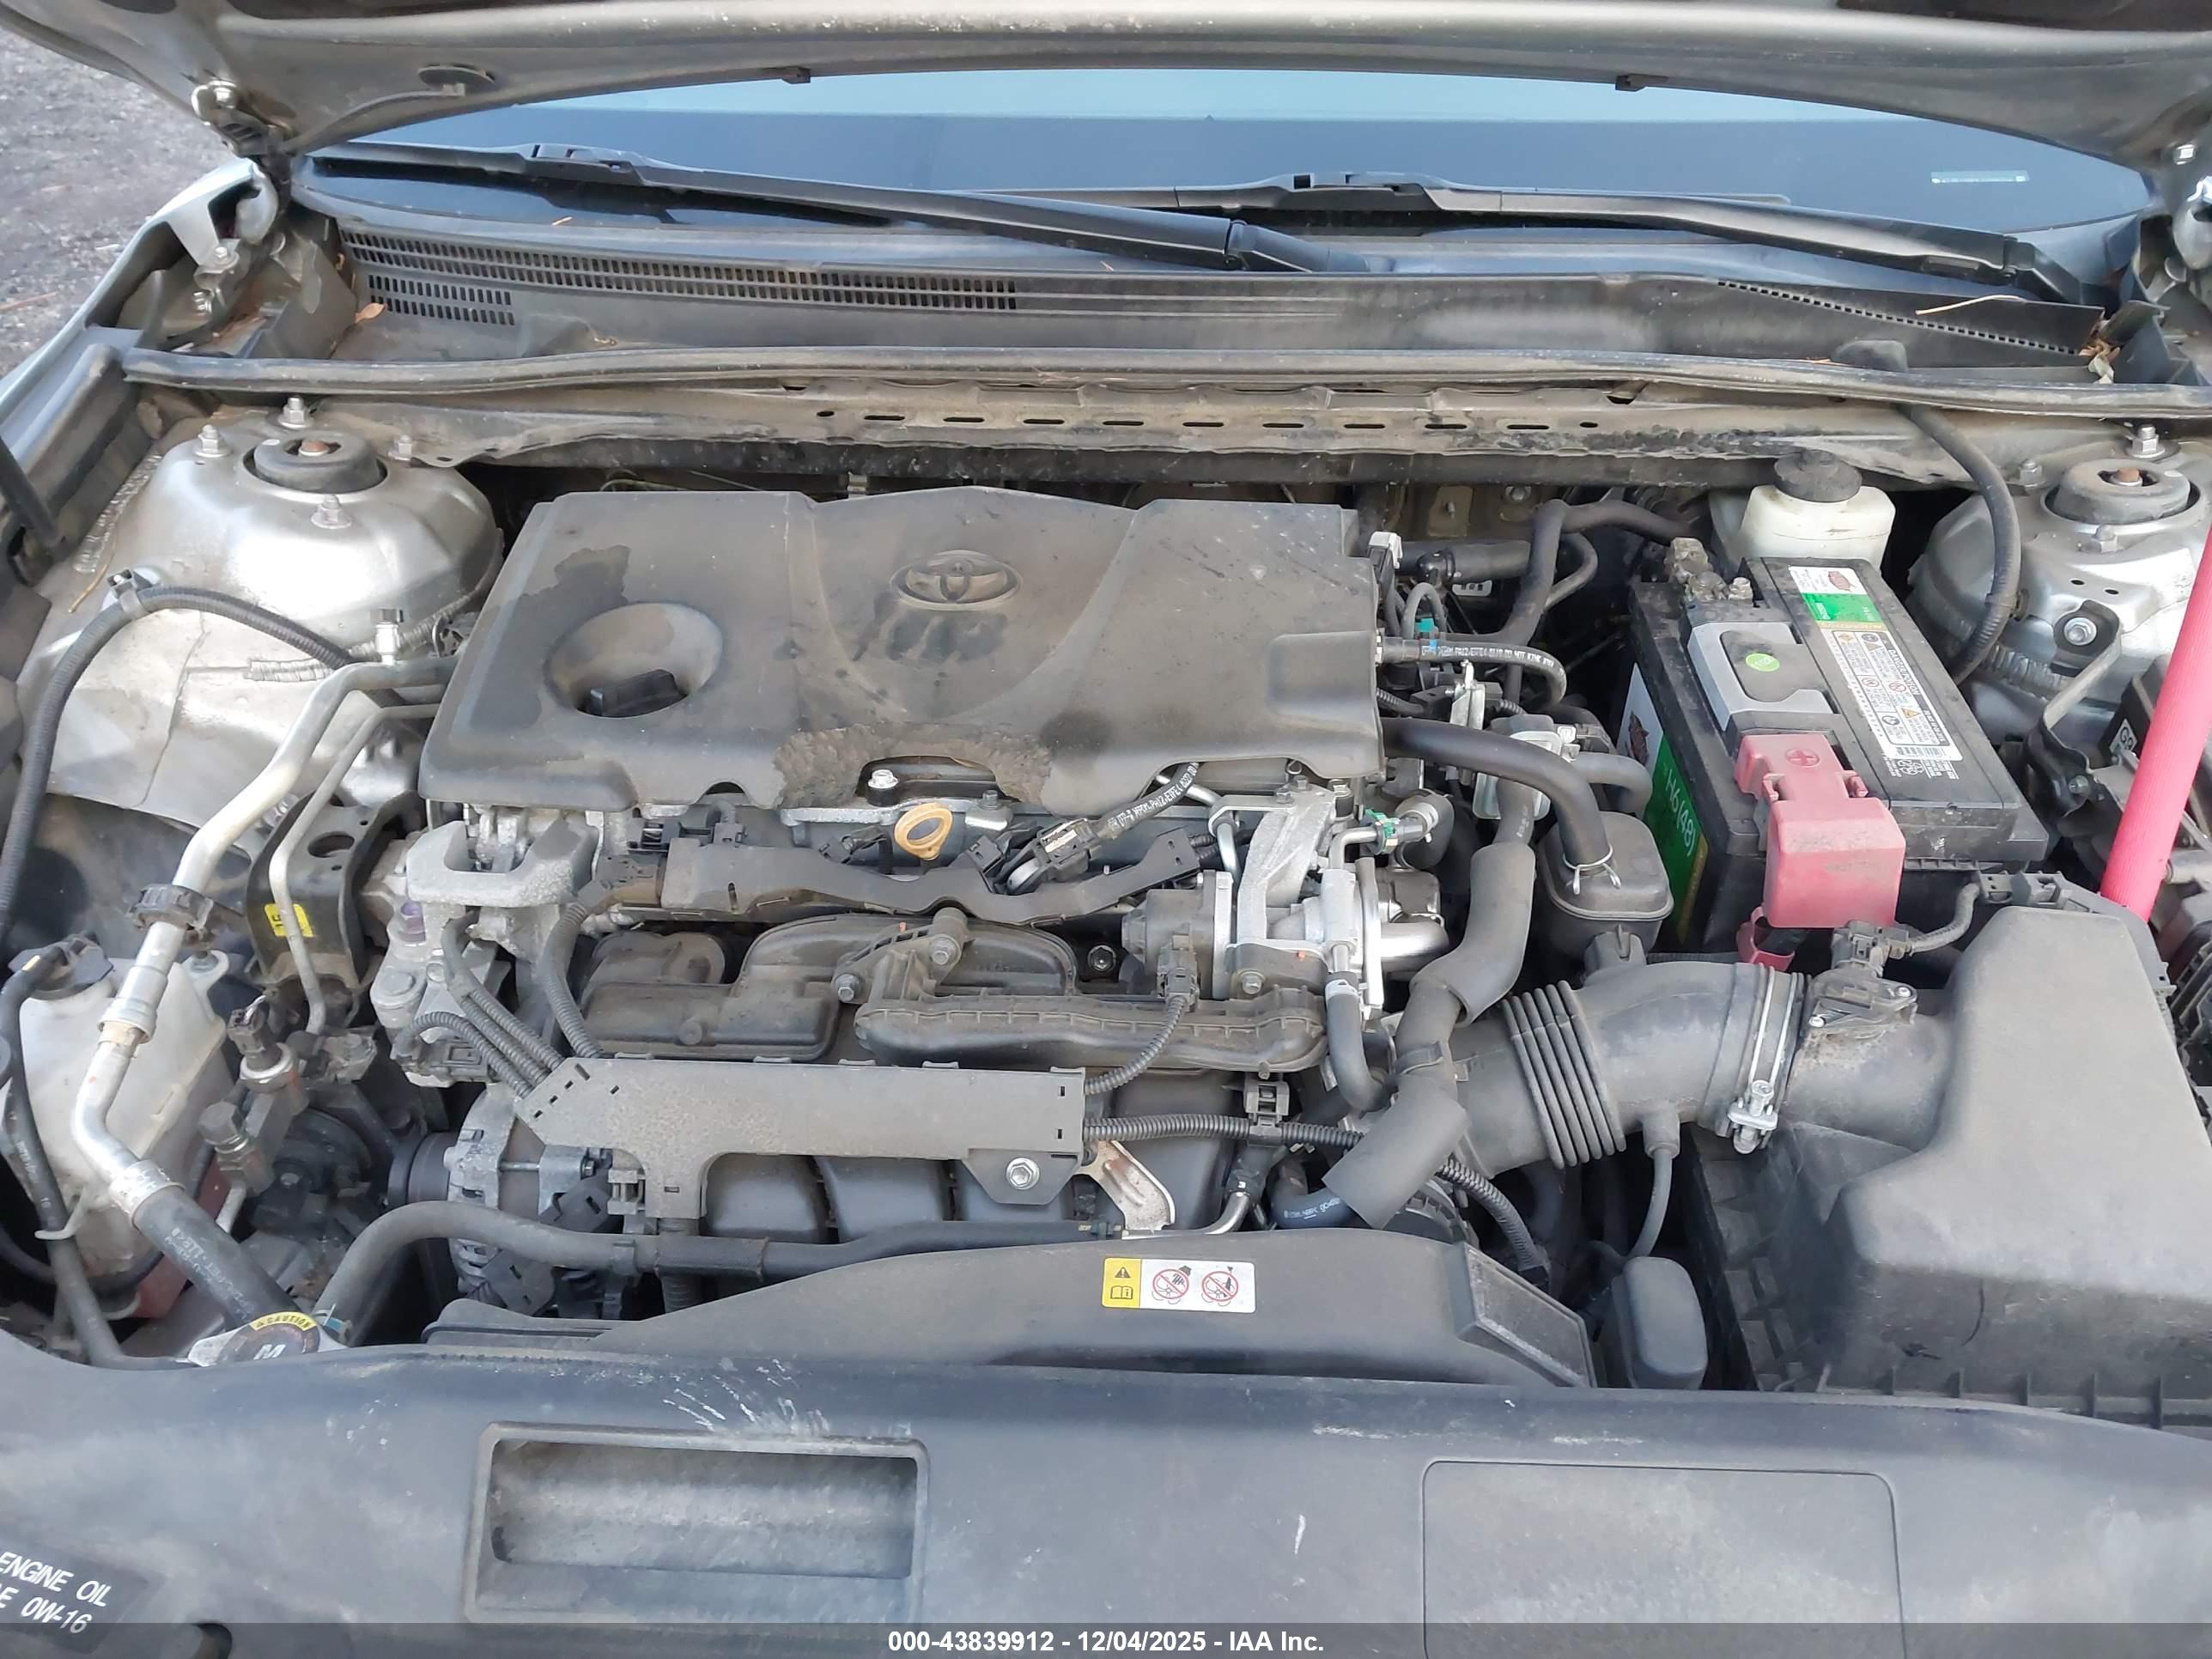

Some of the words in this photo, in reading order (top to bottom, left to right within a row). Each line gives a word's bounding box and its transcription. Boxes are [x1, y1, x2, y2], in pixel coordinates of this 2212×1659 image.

[267, 1315, 310, 1328] CAUTION
[0, 1551, 75, 1592] ENGINE
[76, 1580, 112, 1607] OIL
[21, 1596, 92, 1633] 0W-16
